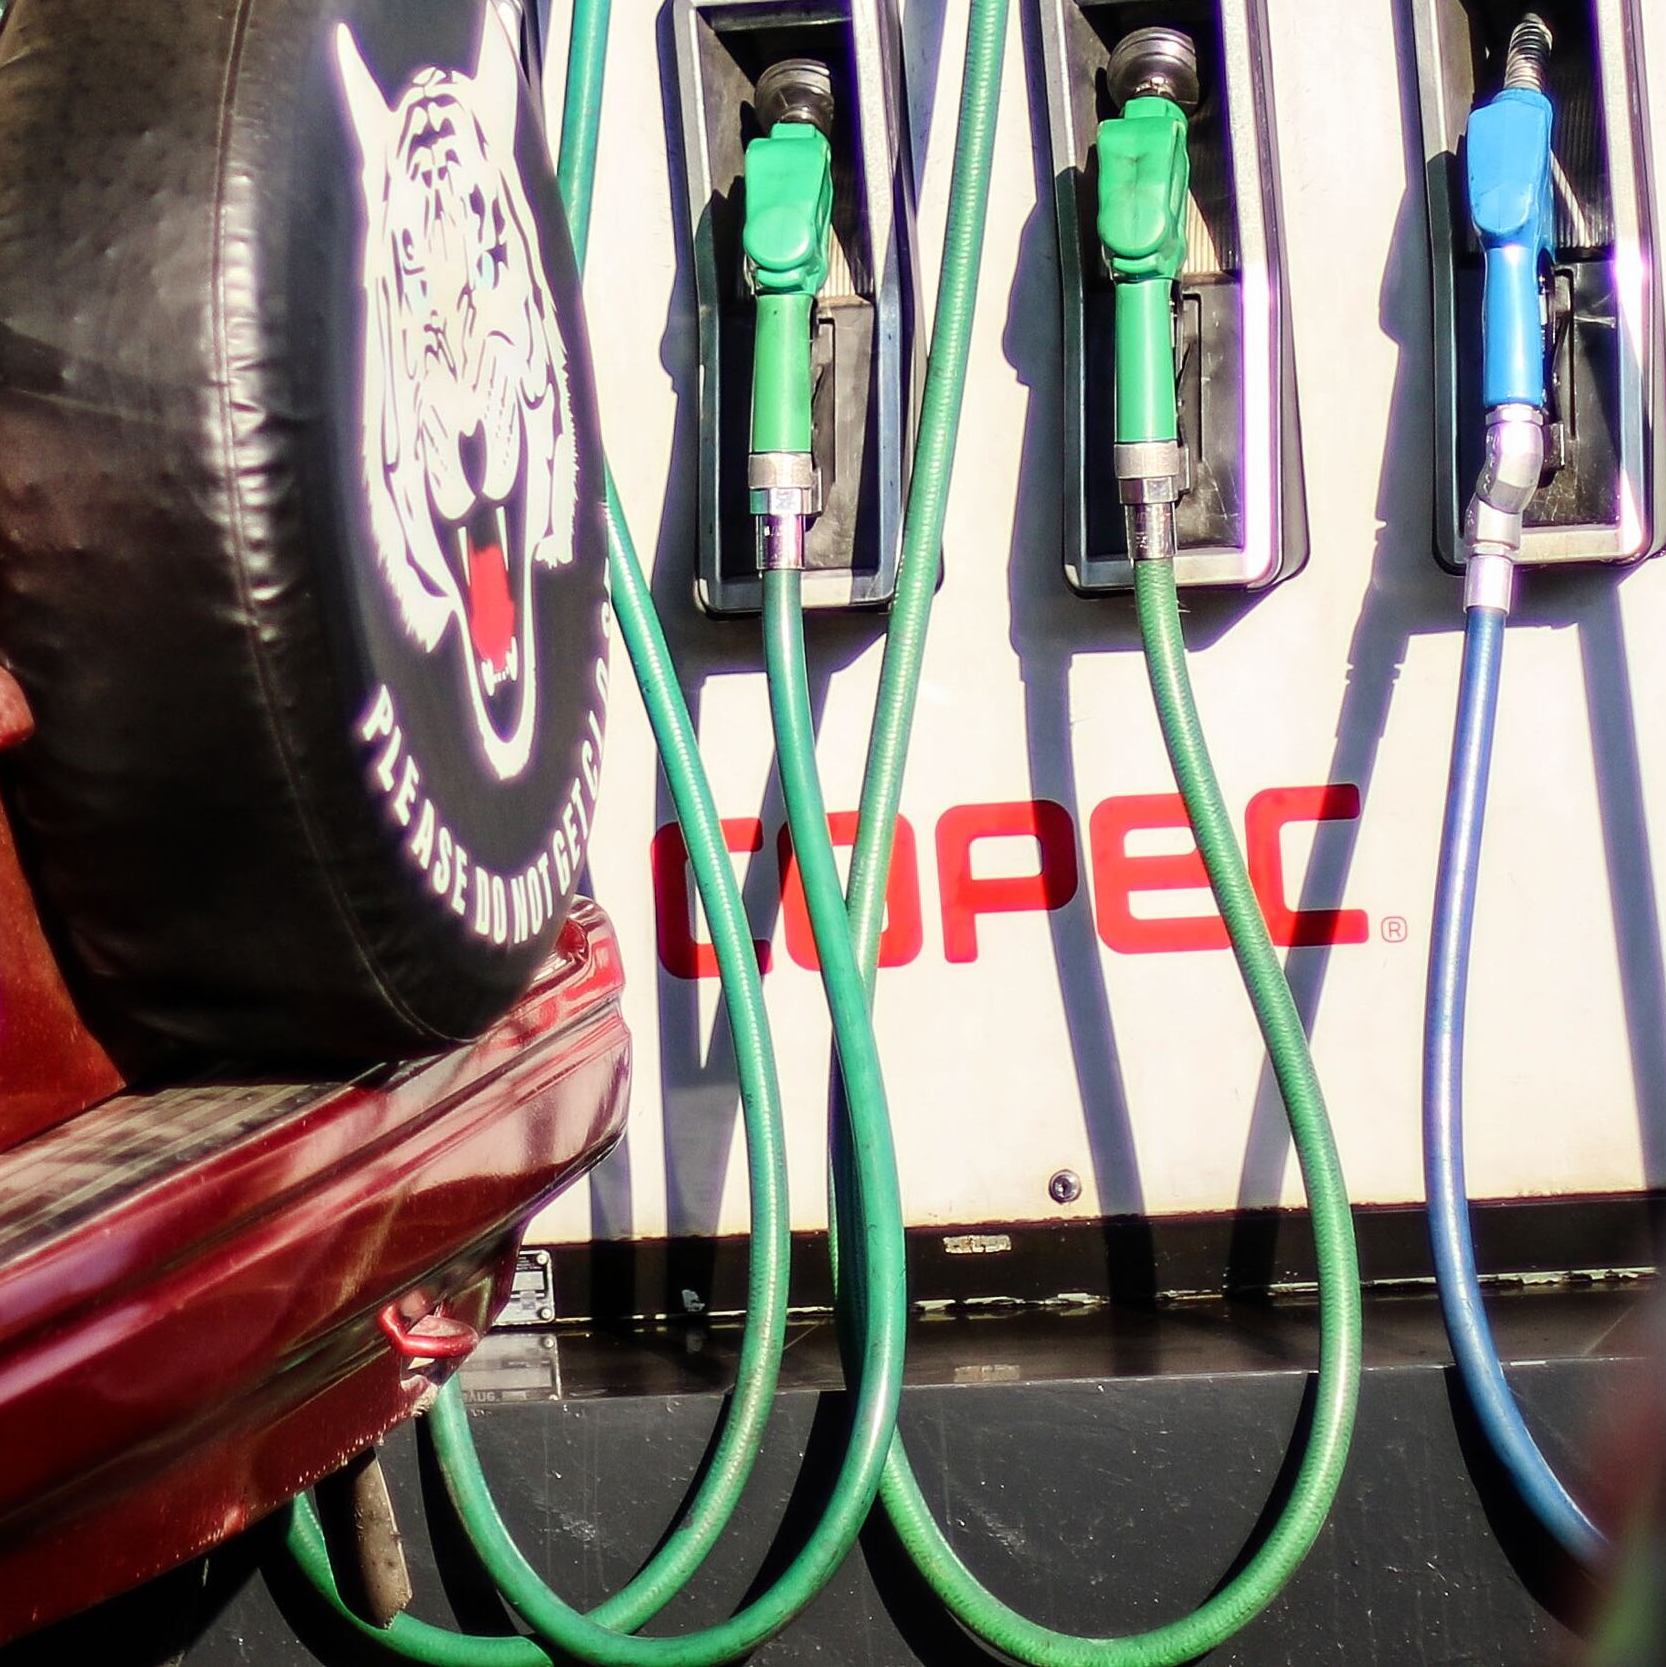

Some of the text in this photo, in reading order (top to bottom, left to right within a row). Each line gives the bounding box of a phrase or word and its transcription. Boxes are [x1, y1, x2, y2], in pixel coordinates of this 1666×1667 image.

[360, 683, 468, 917] PLEASE
[475, 865, 508, 945] DO
[510, 852, 553, 945] NOT
[553, 777, 589, 896] GET
[650, 783, 1370, 981] COPEC
